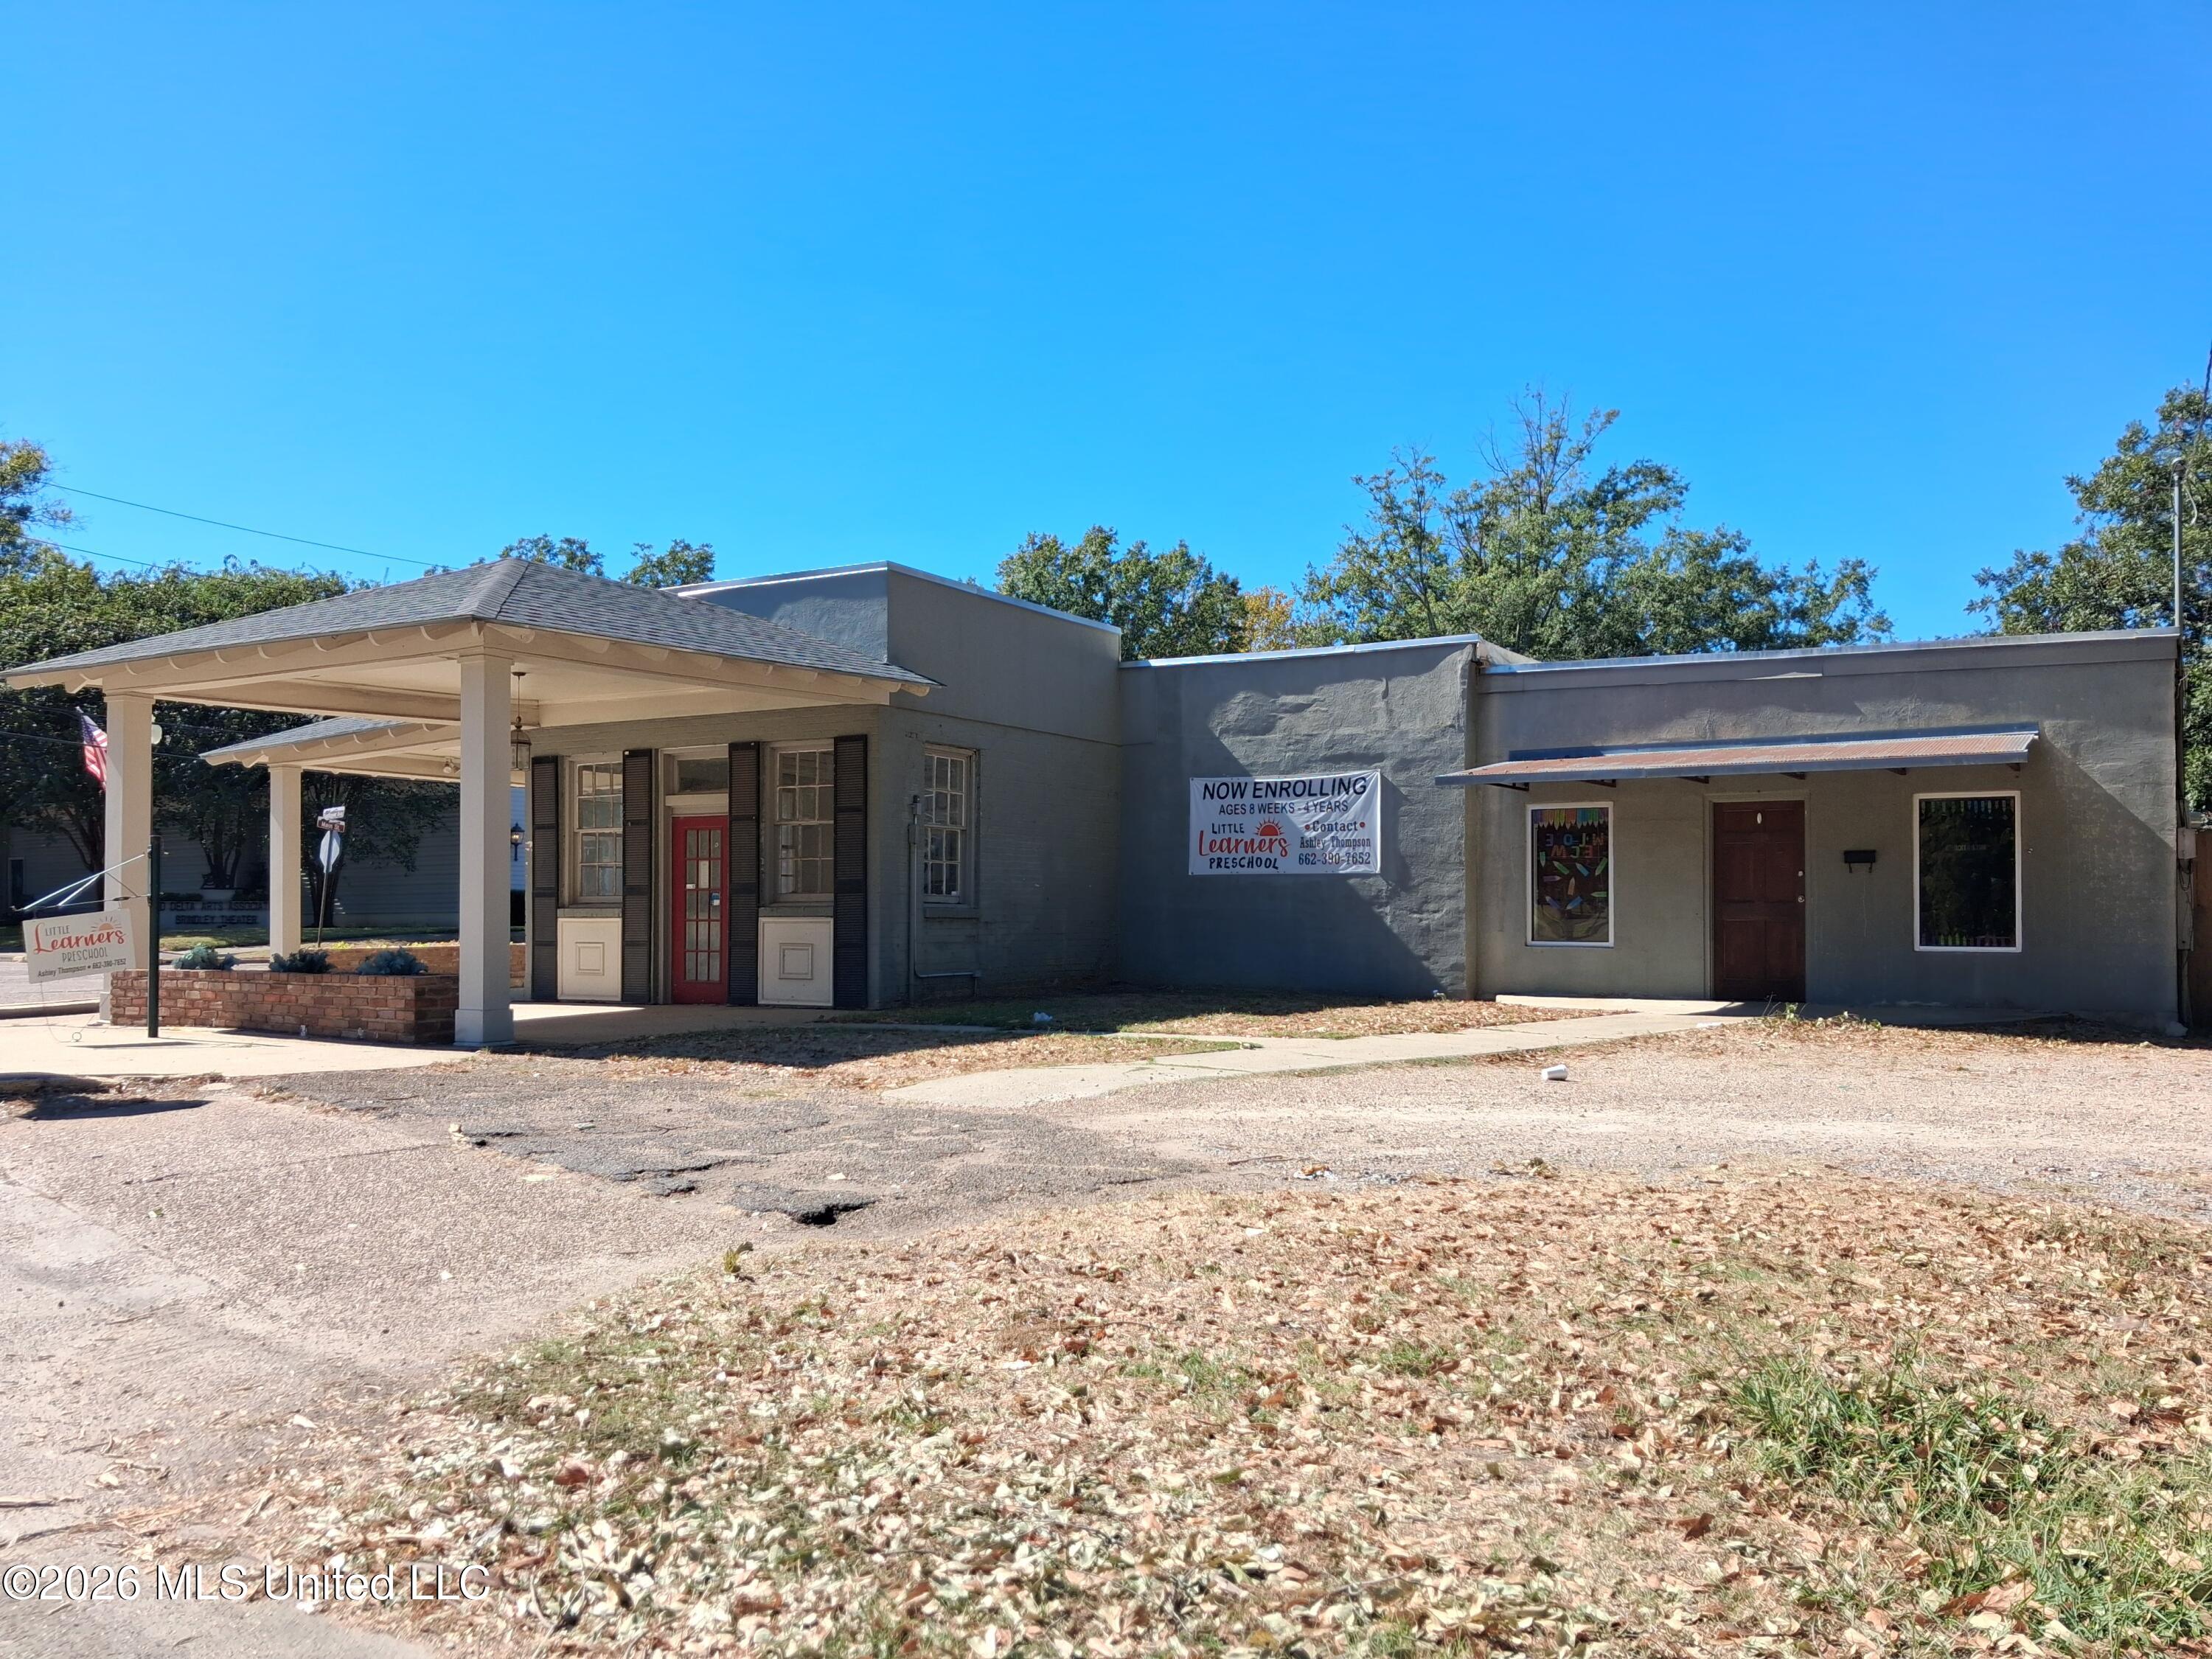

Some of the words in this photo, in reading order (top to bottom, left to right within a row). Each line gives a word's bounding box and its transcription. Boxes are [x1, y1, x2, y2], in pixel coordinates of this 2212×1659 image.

[1203, 782, 1248, 800] NOW
[1253, 776, 1367, 799] ENROLLING
[1219, 804, 1247, 815] AGES
[1249, 803, 1255, 815] 8
[1257, 802, 1295, 814] WEEKS
[1303, 801, 1310, 813] 4
[1312, 800, 1349, 813] YEARS
[321, 821, 333, 830] Main
[1211, 823, 1245, 834] LITTLE
[1312, 821, 1358, 832] Contact
[1198, 830, 1292, 858] Learners
[1299, 836, 1326, 850] Ashley
[1330, 835, 1371, 849] Thompson
[1209, 857, 1279, 870] PRESCHOOL
[1298, 852, 1371, 865] 662-390-7652
[45, 925, 70, 936] LITTLE
[33, 922, 126, 954] Learners
[62, 947, 108, 962] PRESCHOOL
